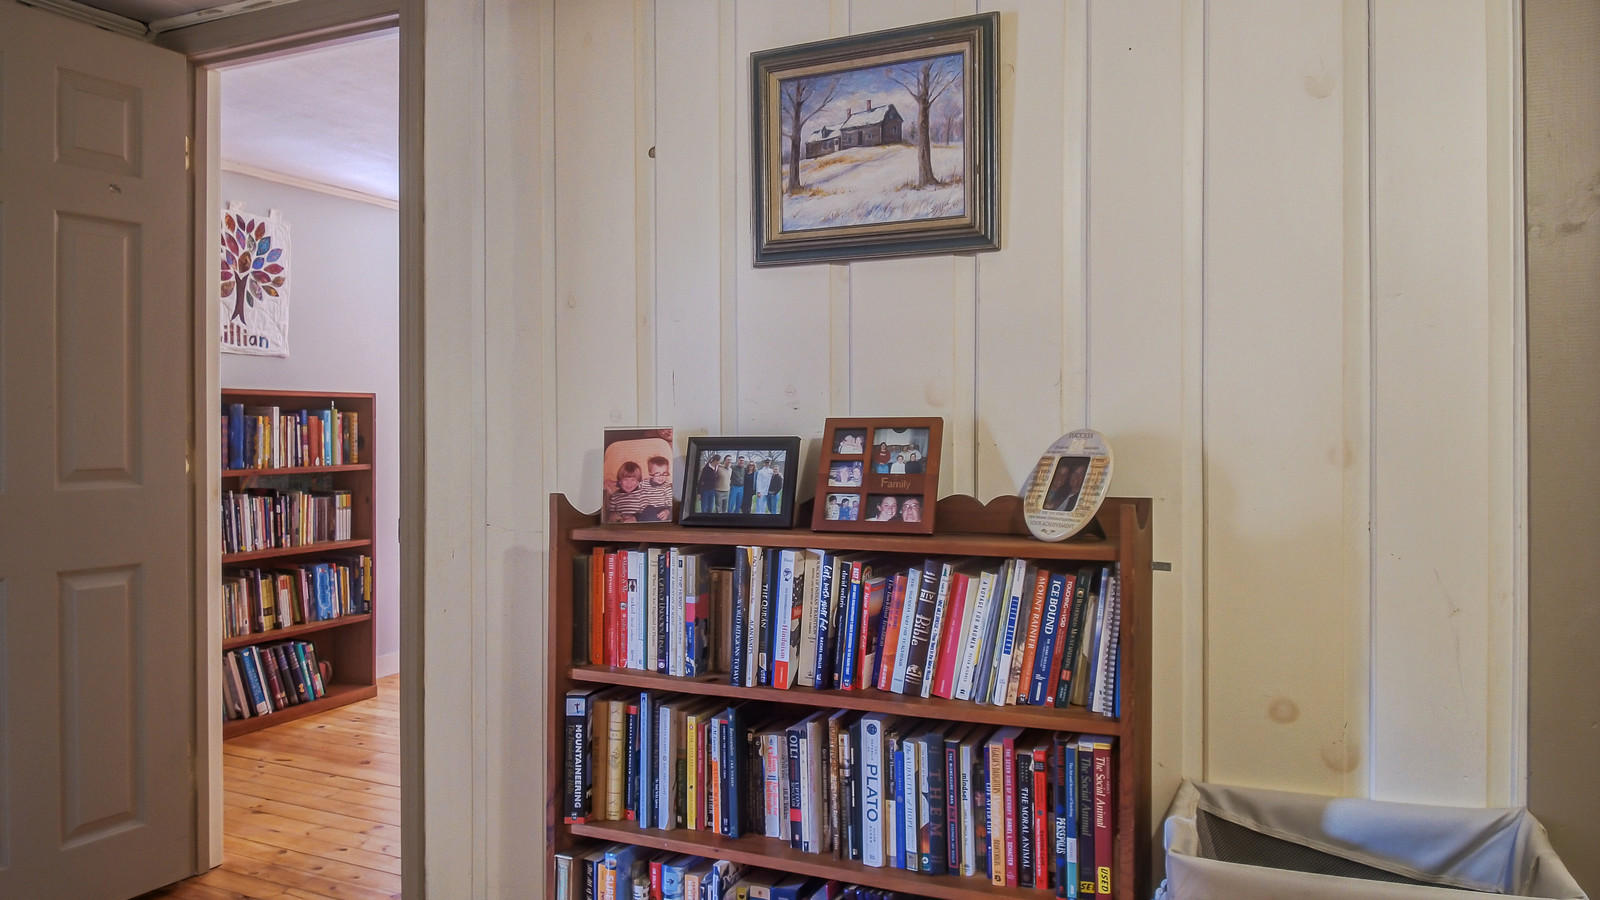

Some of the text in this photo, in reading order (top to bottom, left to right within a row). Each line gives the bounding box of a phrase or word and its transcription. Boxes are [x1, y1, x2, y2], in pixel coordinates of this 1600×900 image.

[221, 322, 269, 348] illian
[880, 477, 912, 490] Family
[840, 570, 848, 587] david
[1051, 579, 1062, 596] ICE
[839, 588, 847, 608] sedaris
[920, 591, 934, 600] NIV
[978, 587, 986, 609] VOYAGE
[1063, 580, 1073, 609] TOUCHING
[735, 598, 743, 623] WORLD
[1028, 576, 1045, 649] MOUNT RAINIER
[1044, 597, 1060, 635] BOUND
[734, 624, 742, 656] RELIGIONS
[780, 624, 788, 660] Hinduism
[911, 614, 931, 646] Bible
[969, 625, 979, 649] MADMEN
[789, 735, 798, 759] OIL!
[574, 724, 582, 809] MOUNTAINEERING
[904, 757, 913, 795] AUDACITY
[866, 763, 879, 823] PLATO
[930, 768, 943, 838] THEM
[1020, 786, 1029, 806] THE
[1081, 756, 1092, 837] The Social Animal
[1096, 756, 1107, 829] The Social Animal
[1021, 807, 1030, 834] MORAL
[1056, 816, 1066, 855] PERSEPOLIS
[1021, 835, 1031, 869] ANIMAL
[1100, 867, 1110, 892] USED
